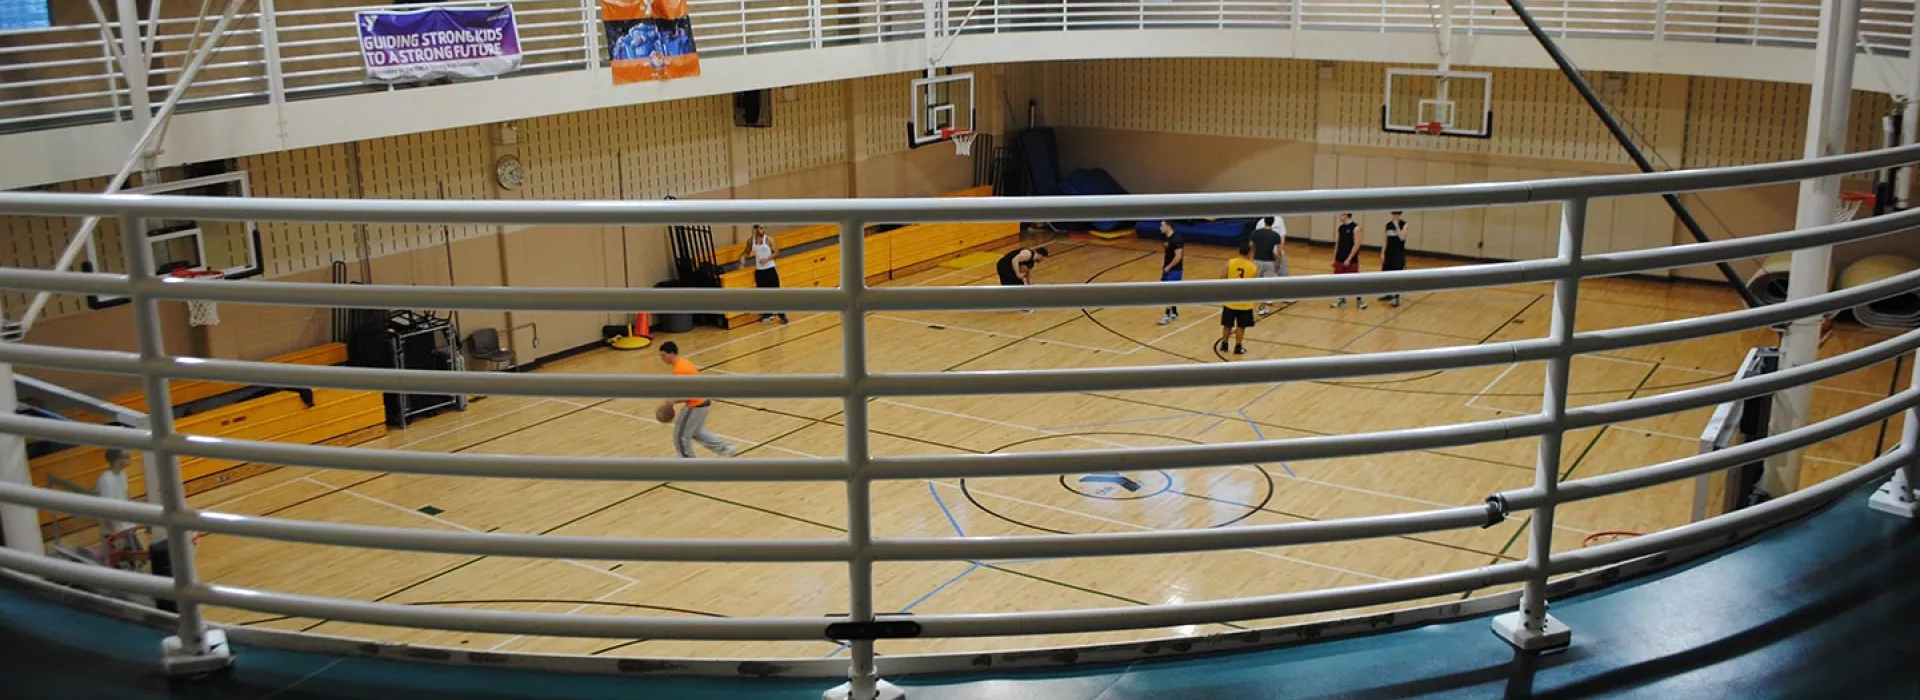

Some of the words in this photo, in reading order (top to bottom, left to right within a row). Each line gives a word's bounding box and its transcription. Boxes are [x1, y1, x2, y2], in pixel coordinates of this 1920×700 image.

[363, 15, 378, 32] Y
[364, 34, 419, 50] GUIDING
[422, 30, 474, 45] STRONG
[475, 27, 503, 42] KIDS
[366, 50, 385, 65] TO
[388, 50, 400, 64] A
[399, 46, 453, 63] STRONG
[453, 42, 502, 58] FUTURE
[1237, 267, 1245, 278] 3
